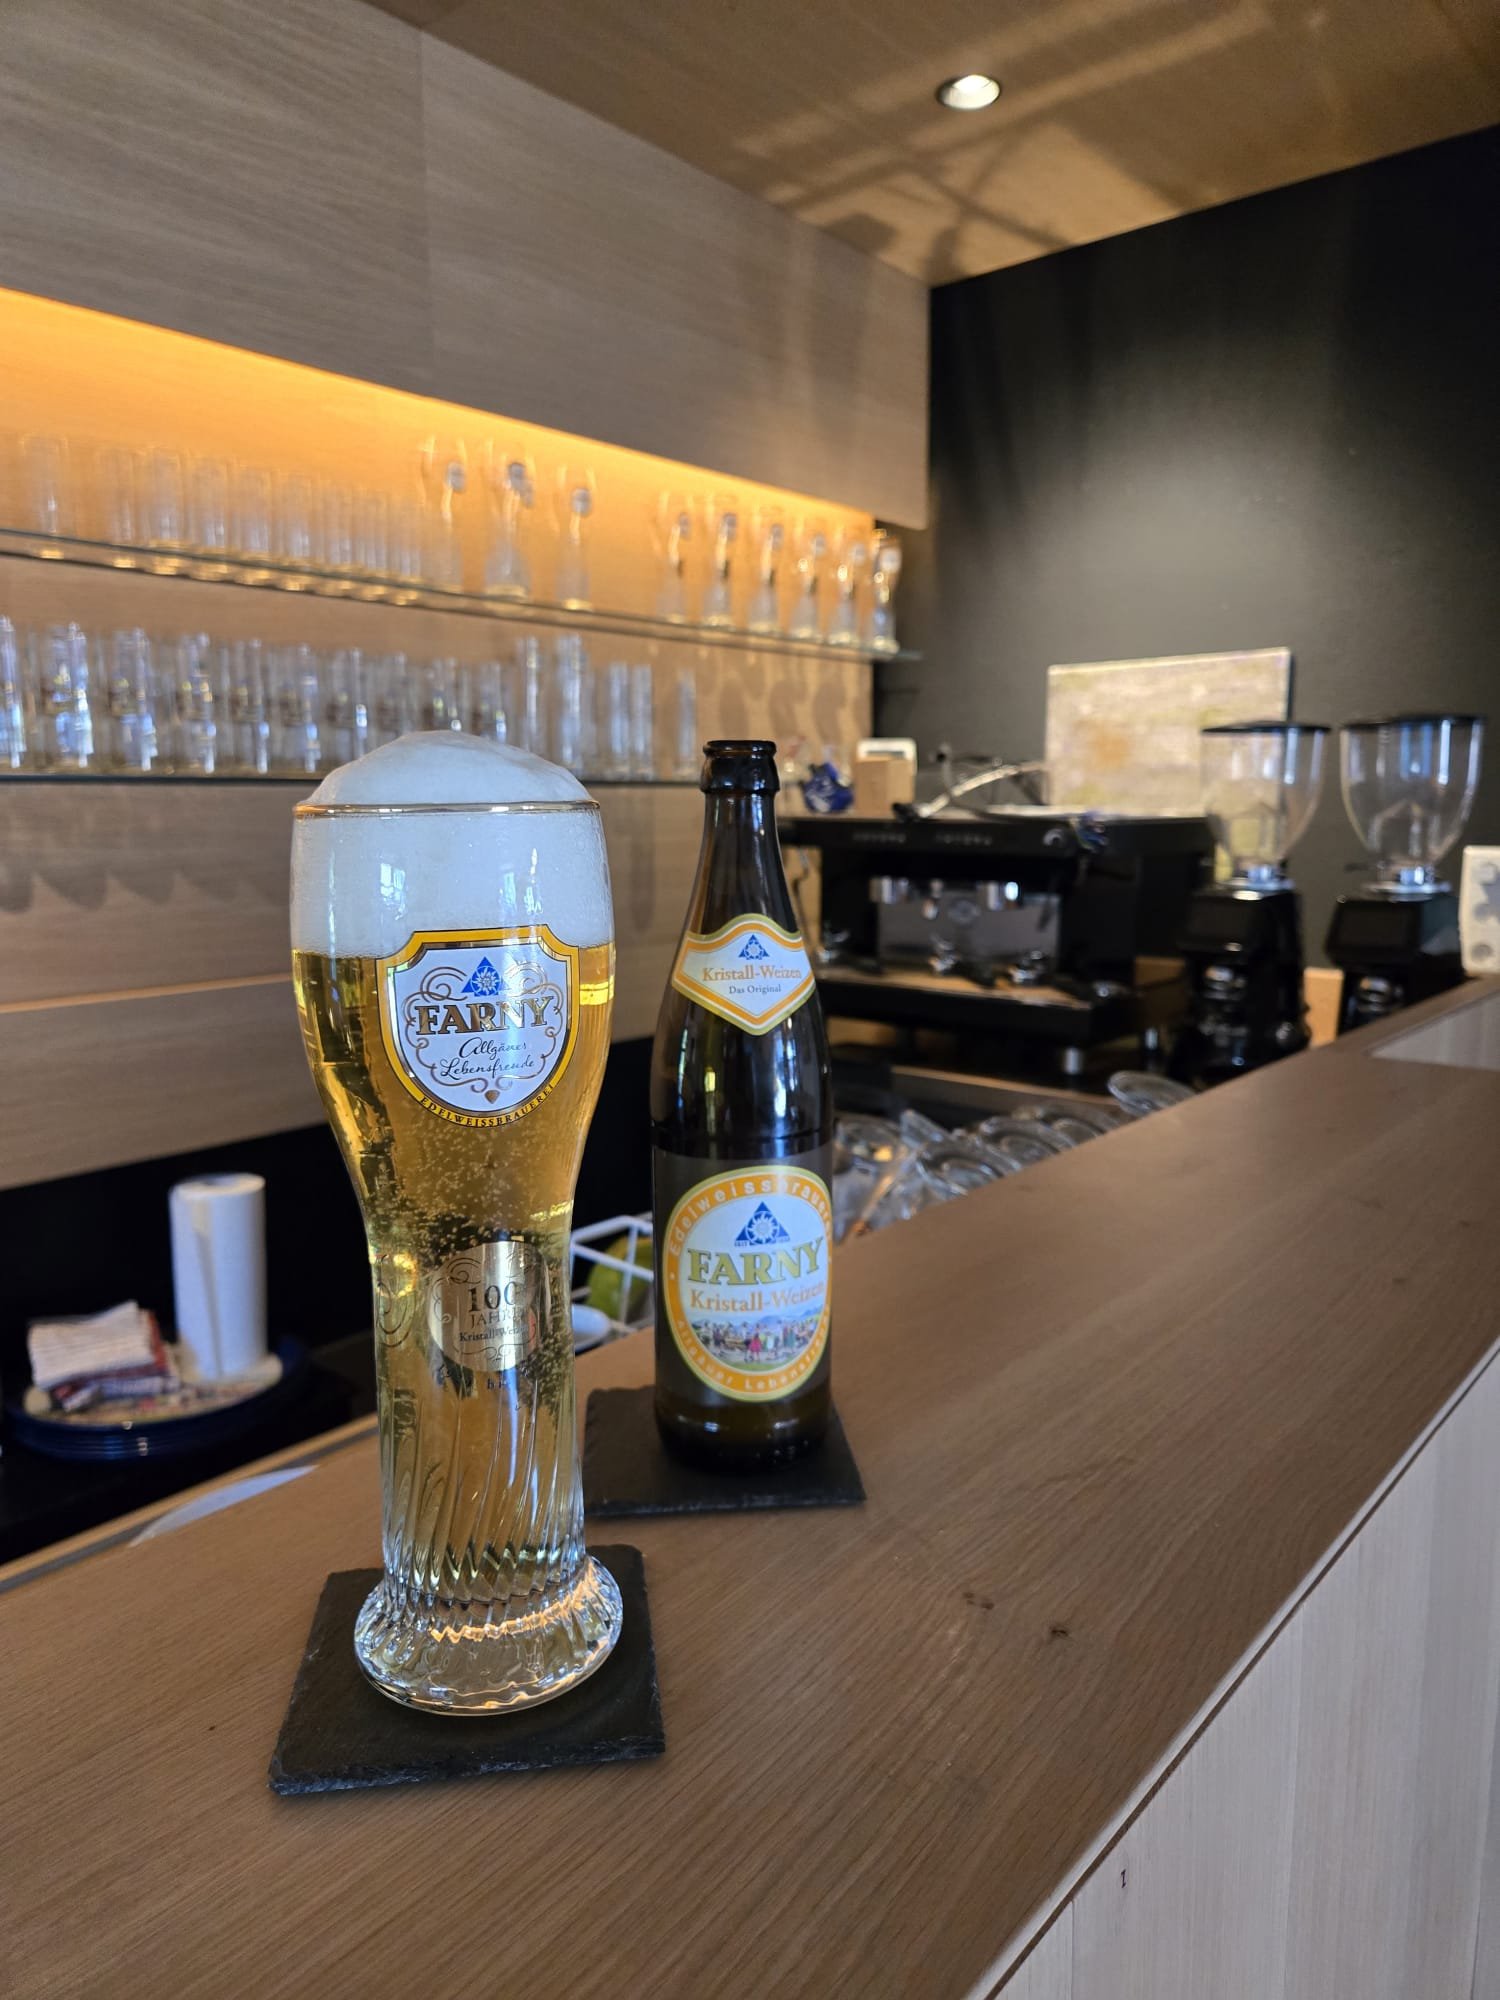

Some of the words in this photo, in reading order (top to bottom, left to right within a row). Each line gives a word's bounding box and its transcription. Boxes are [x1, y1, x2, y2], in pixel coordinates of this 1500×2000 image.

[702, 964, 801, 982] Kristall-Weizen
[729, 985, 745, 995] Das
[747, 984, 782, 995] Original
[414, 996, 554, 1036] FARNY
[440, 1053, 534, 1081] Lebensfreude
[420, 1083, 554, 1128] EDELWEISSBRAUEREI
[688, 1236, 824, 1286] FARNY
[459, 1327, 529, 1342] Kristall-Weiz
